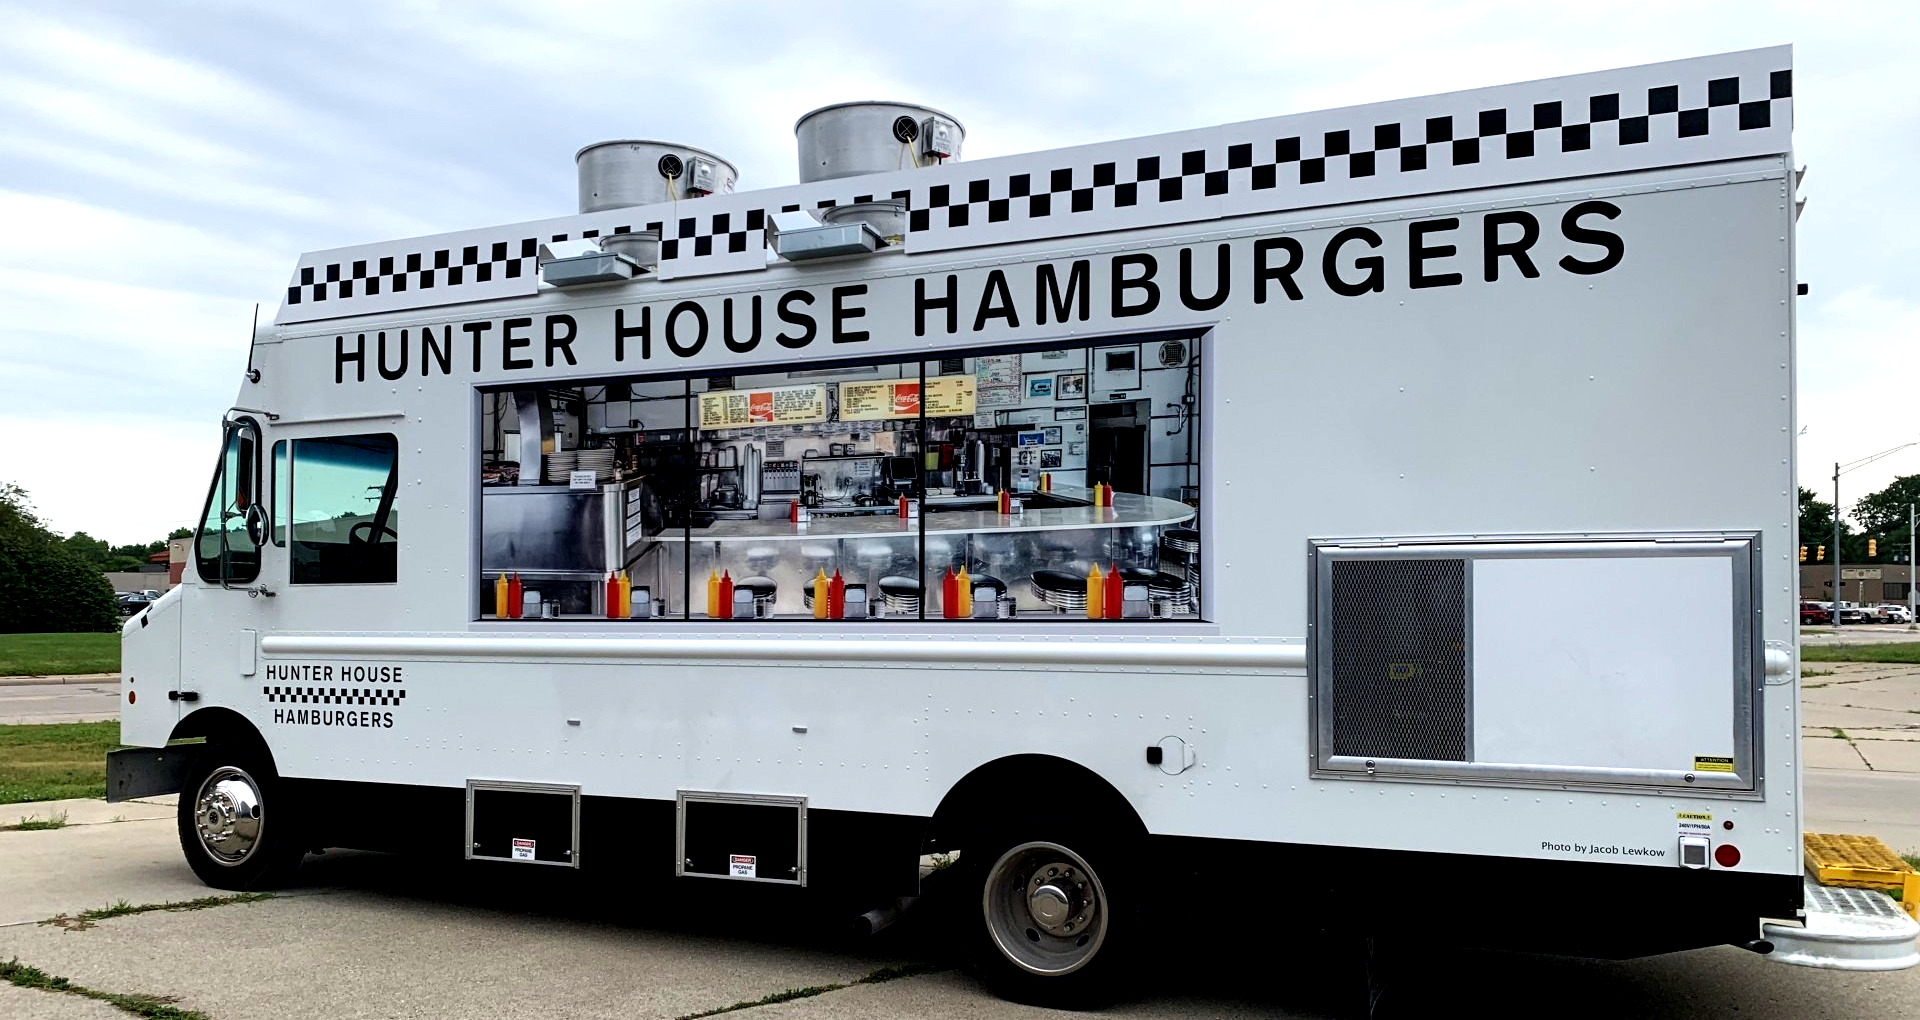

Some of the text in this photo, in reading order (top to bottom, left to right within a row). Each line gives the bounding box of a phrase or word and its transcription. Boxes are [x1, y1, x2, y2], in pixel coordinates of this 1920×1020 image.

[335, 200, 1626, 384] HUNTER HOUSE HAMBURGERS
[266, 664, 403, 683] HUNTER HOUSE
[274, 708, 394, 729] HAMBURGERS
[1541, 841, 1665, 857] Photo by Jacob Lewkow
